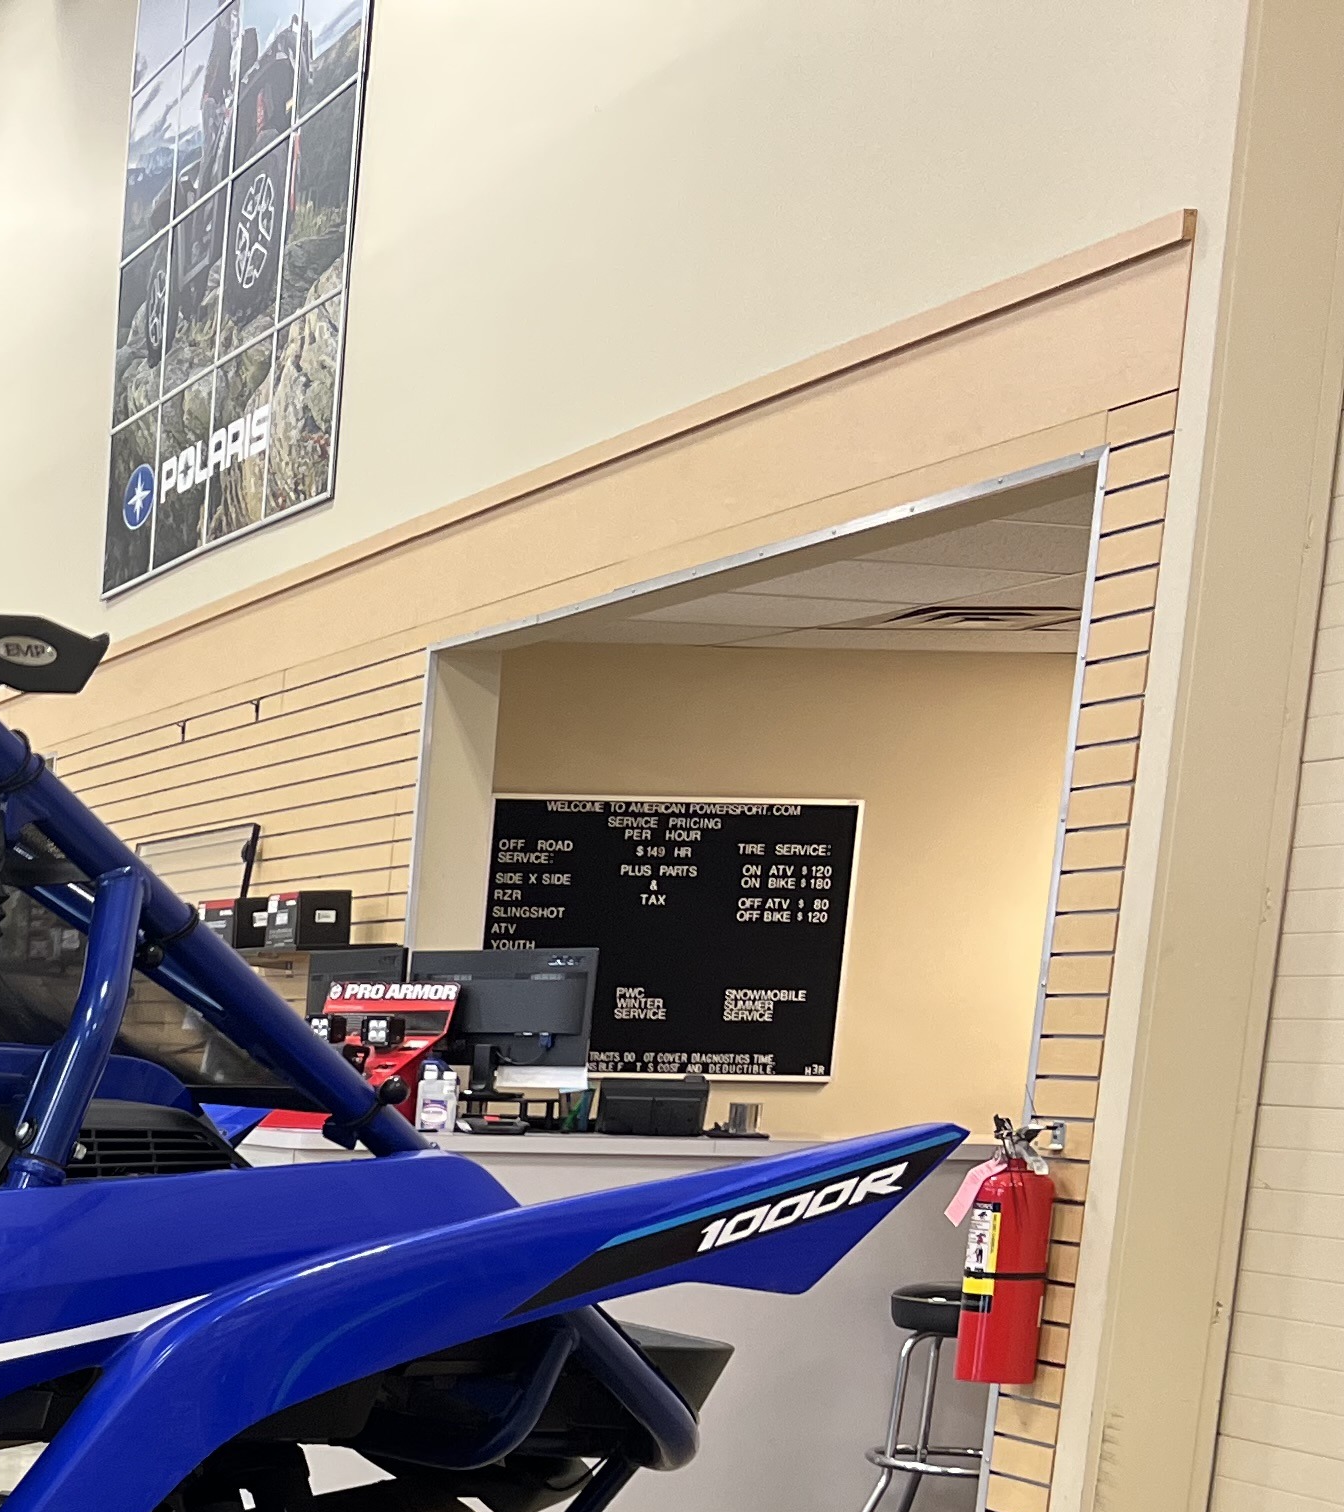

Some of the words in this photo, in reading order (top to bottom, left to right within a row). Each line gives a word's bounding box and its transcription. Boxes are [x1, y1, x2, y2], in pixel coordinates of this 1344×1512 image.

[160, 403, 271, 504] POLARIS
[5, 642, 45, 658] EMP
[546, 801, 604, 812] WELCOME
[610, 802, 625, 813] TO
[628, 803, 685, 814] AMERICAN
[608, 817, 658, 828] SERVICE
[669, 818, 722, 830] PRICING
[624, 830, 651, 840] PER
[665, 830, 701, 841] HOUR
[499, 839, 525, 850] OFF
[537, 840, 573, 851] ROAD
[737, 843, 766, 855] TIRE
[775, 844, 832, 856] SERVICE:
[497, 852, 554, 864] SERVICE:
[674, 847, 691, 858] HR
[620, 865, 652, 876] PLUS
[659, 865, 697, 877] PARTS
[742, 864, 761, 876] ON
[769, 865, 794, 876] ATV
[495, 873, 523, 884] SIDE
[528, 874, 537, 884] X
[542, 874, 571, 885] SIDE
[649, 879, 658, 891] &
[741, 877, 760, 889] ON
[768, 877, 796, 889] BIKE
[494, 889, 521, 900] RZR
[641, 894, 666, 906] TAX
[738, 898, 763, 909] OFF
[765, 898, 790, 909] ATV
[492, 907, 565, 918] SLINGSHOT
[736, 910, 761, 922] OFF
[763, 911, 791, 922] BIKE
[491, 923, 516, 934] ATV
[490, 939, 535, 950] YOUTH
[344, 983, 385, 1000] PRO
[385, 984, 458, 1001] ARMOR
[616, 987, 645, 998] PWC
[725, 989, 807, 1001] SNOWMOBILE
[616, 998, 664, 1009] WINTER
[723, 1000, 774, 1011] SUMMER
[614, 1008, 667, 1020] SERVICE
[723, 1010, 773, 1022] SERVICE
[623, 1052, 636, 1062] DO
[657, 1052, 688, 1063] COVER
[691, 1052, 750, 1064] DIAGNOSTICS
[657, 1063, 680, 1073] COST
[686, 1063, 703, 1073] AND
[697, 1161, 909, 1252] 1000R
